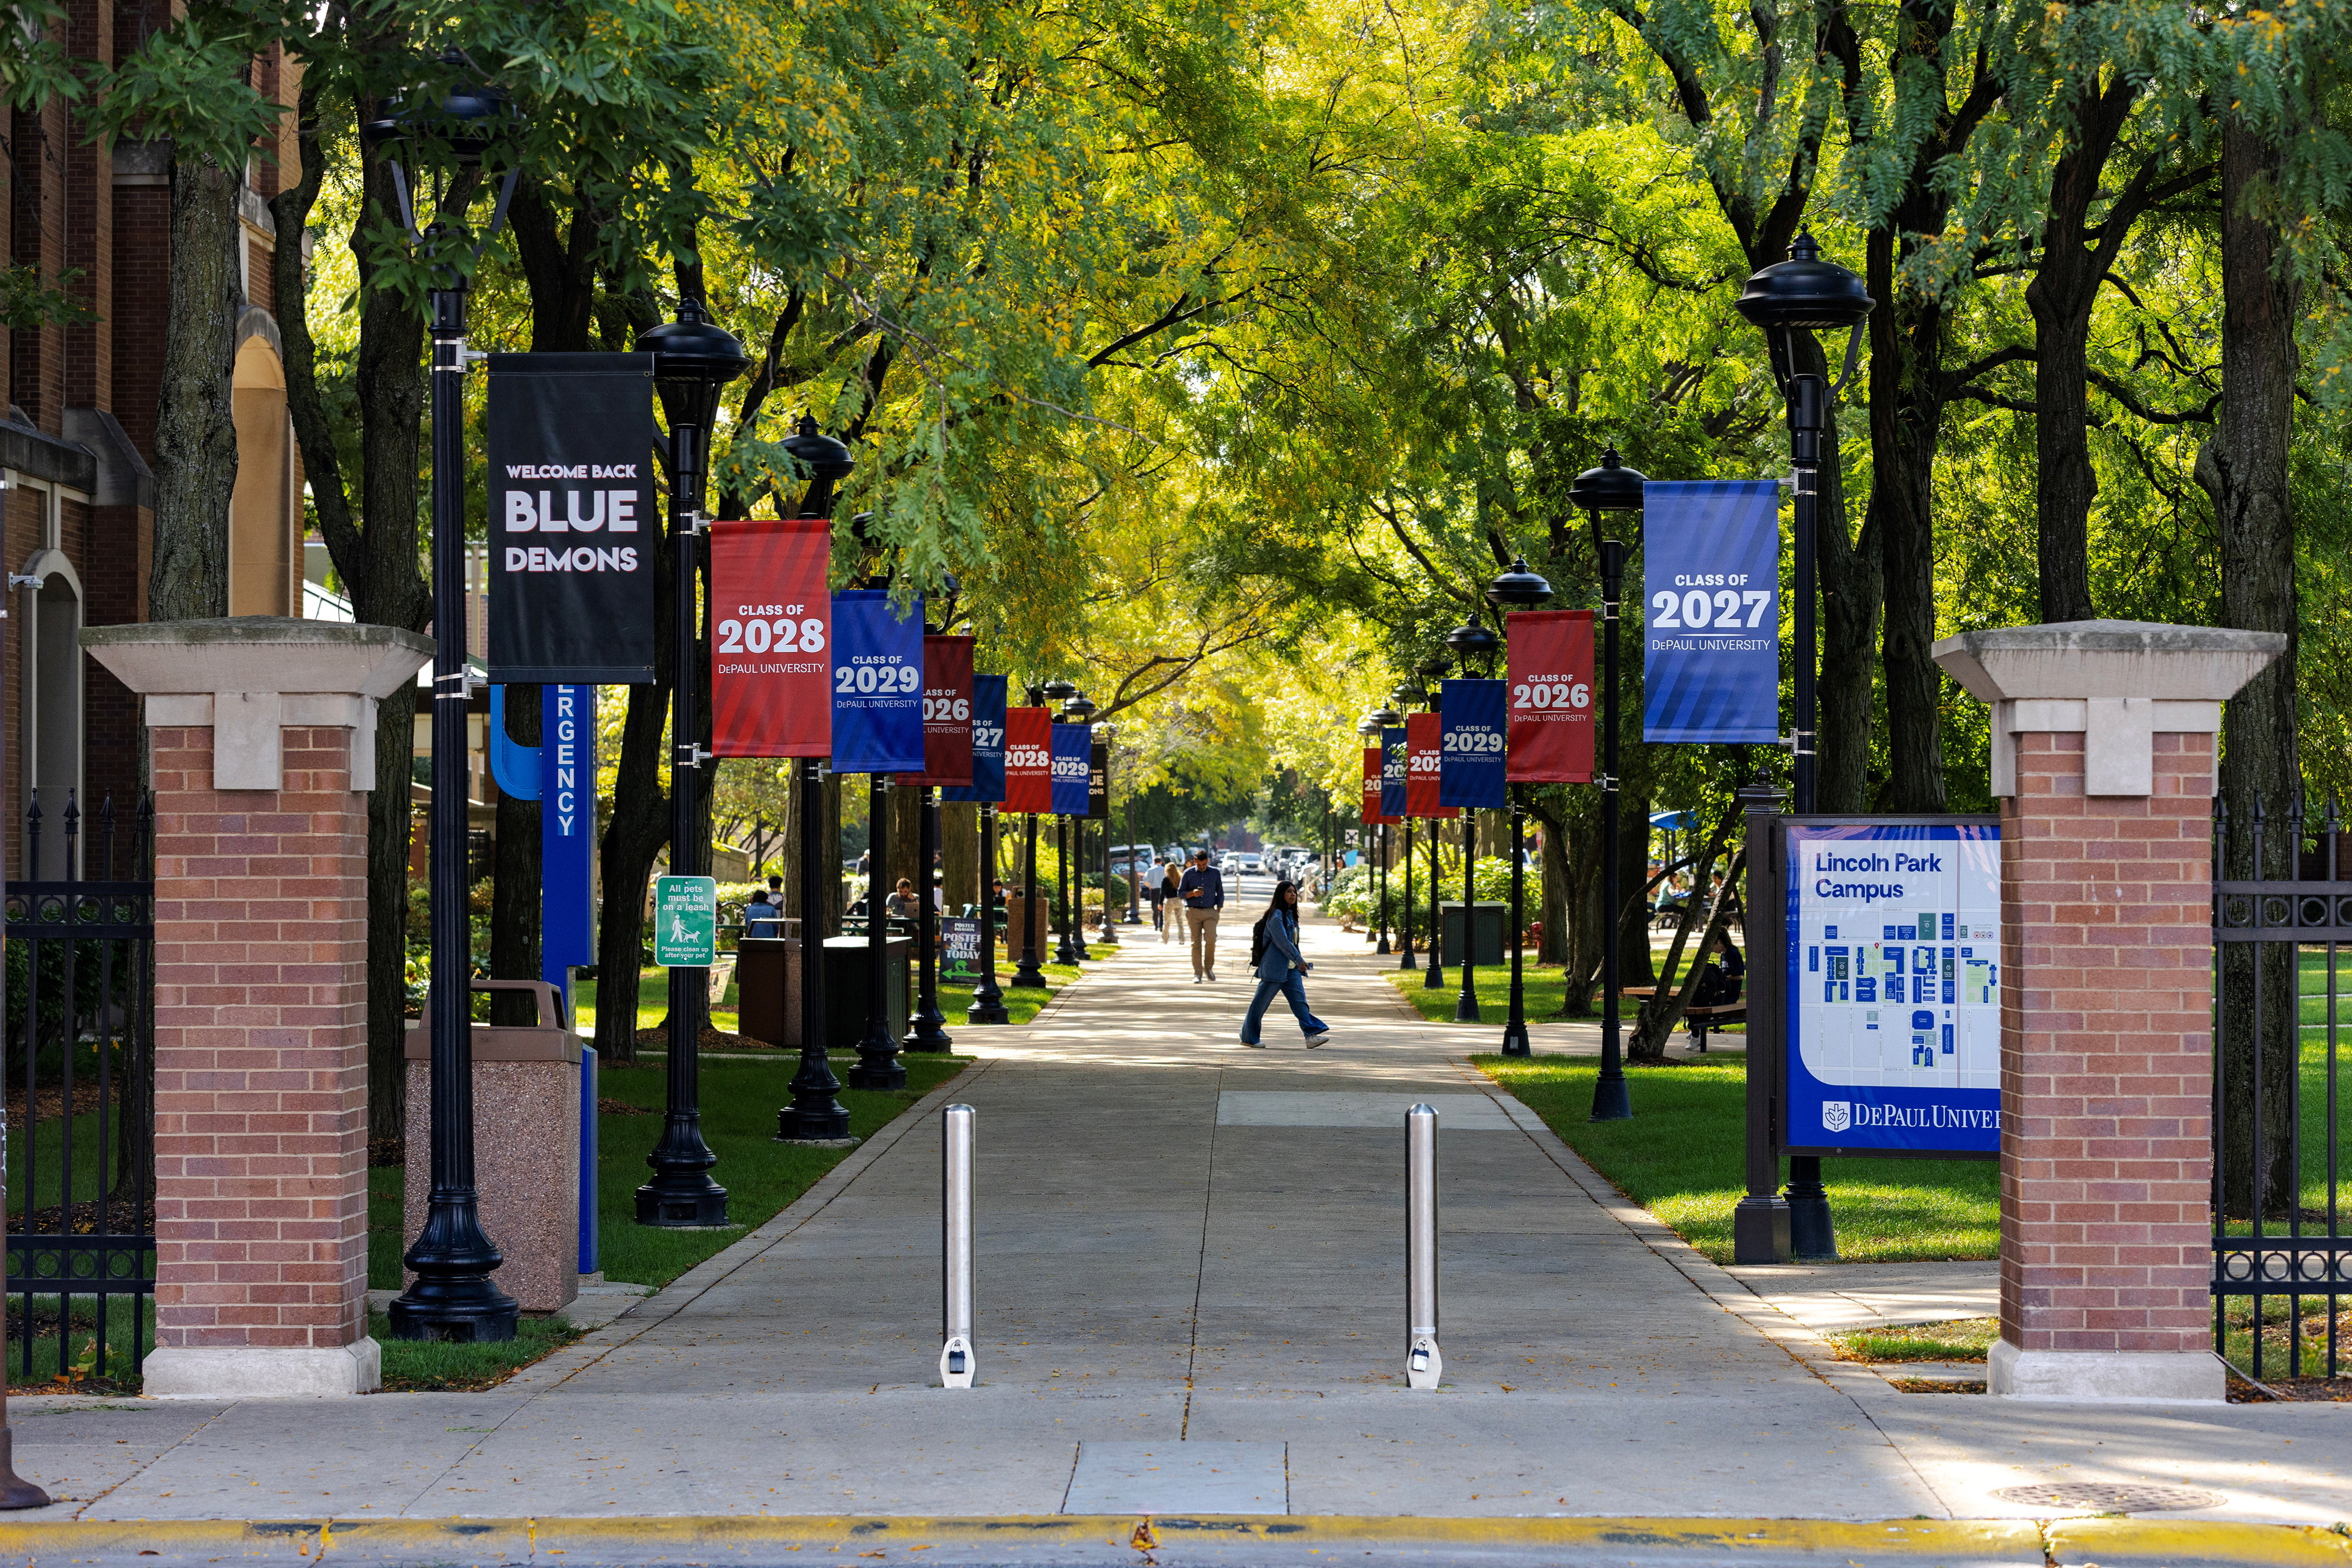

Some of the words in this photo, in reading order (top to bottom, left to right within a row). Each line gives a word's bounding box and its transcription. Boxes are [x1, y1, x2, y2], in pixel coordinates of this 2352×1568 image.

[506, 464, 587, 479] WELCOME
[592, 464, 637, 478] BACK
[506, 490, 637, 532] BLUE
[506, 547, 638, 571] DEMONS
[1675, 574, 1725, 586] CLASS
[1728, 574, 1748, 586] OF
[739, 604, 783, 616] CLASS
[786, 604, 804, 616] OF
[1652, 590, 1771, 628] 2027
[718, 618, 825, 653] 2028
[1699, 640, 1770, 650] UNIVERSITY
[760, 663, 825, 673] UNIVERSITY
[852, 656, 887, 664] CLASS
[888, 656, 903, 664] OF
[836, 666, 919, 693] 2029
[1528, 674, 1559, 683] CLASS
[1561, 674, 1573, 682] OF
[1514, 683, 1589, 708] 2026
[868, 700, 918, 708] UNIVERSITY
[923, 698, 969, 721] 026
[972, 727, 1003, 747] 27
[1444, 733, 1503, 753] 2029
[558, 684, 574, 836] RGENCY
[1004, 750, 1049, 767] 2028
[1409, 755, 1441, 772] 202
[1051, 761, 1088, 776] 2029
[1384, 764, 1404, 778] 20
[1089, 775, 1104, 786] UE
[1364, 779, 1381, 791] 20
[1816, 852, 1889, 872] Lincoln
[1895, 852, 1942, 872] Park
[684, 885, 703, 894] pets
[1815, 878, 1904, 904] Campus
[951, 941, 976, 951] SALE
[946, 950, 980, 959] TODAY
[1931, 1105, 2001, 1129] UNIVE
